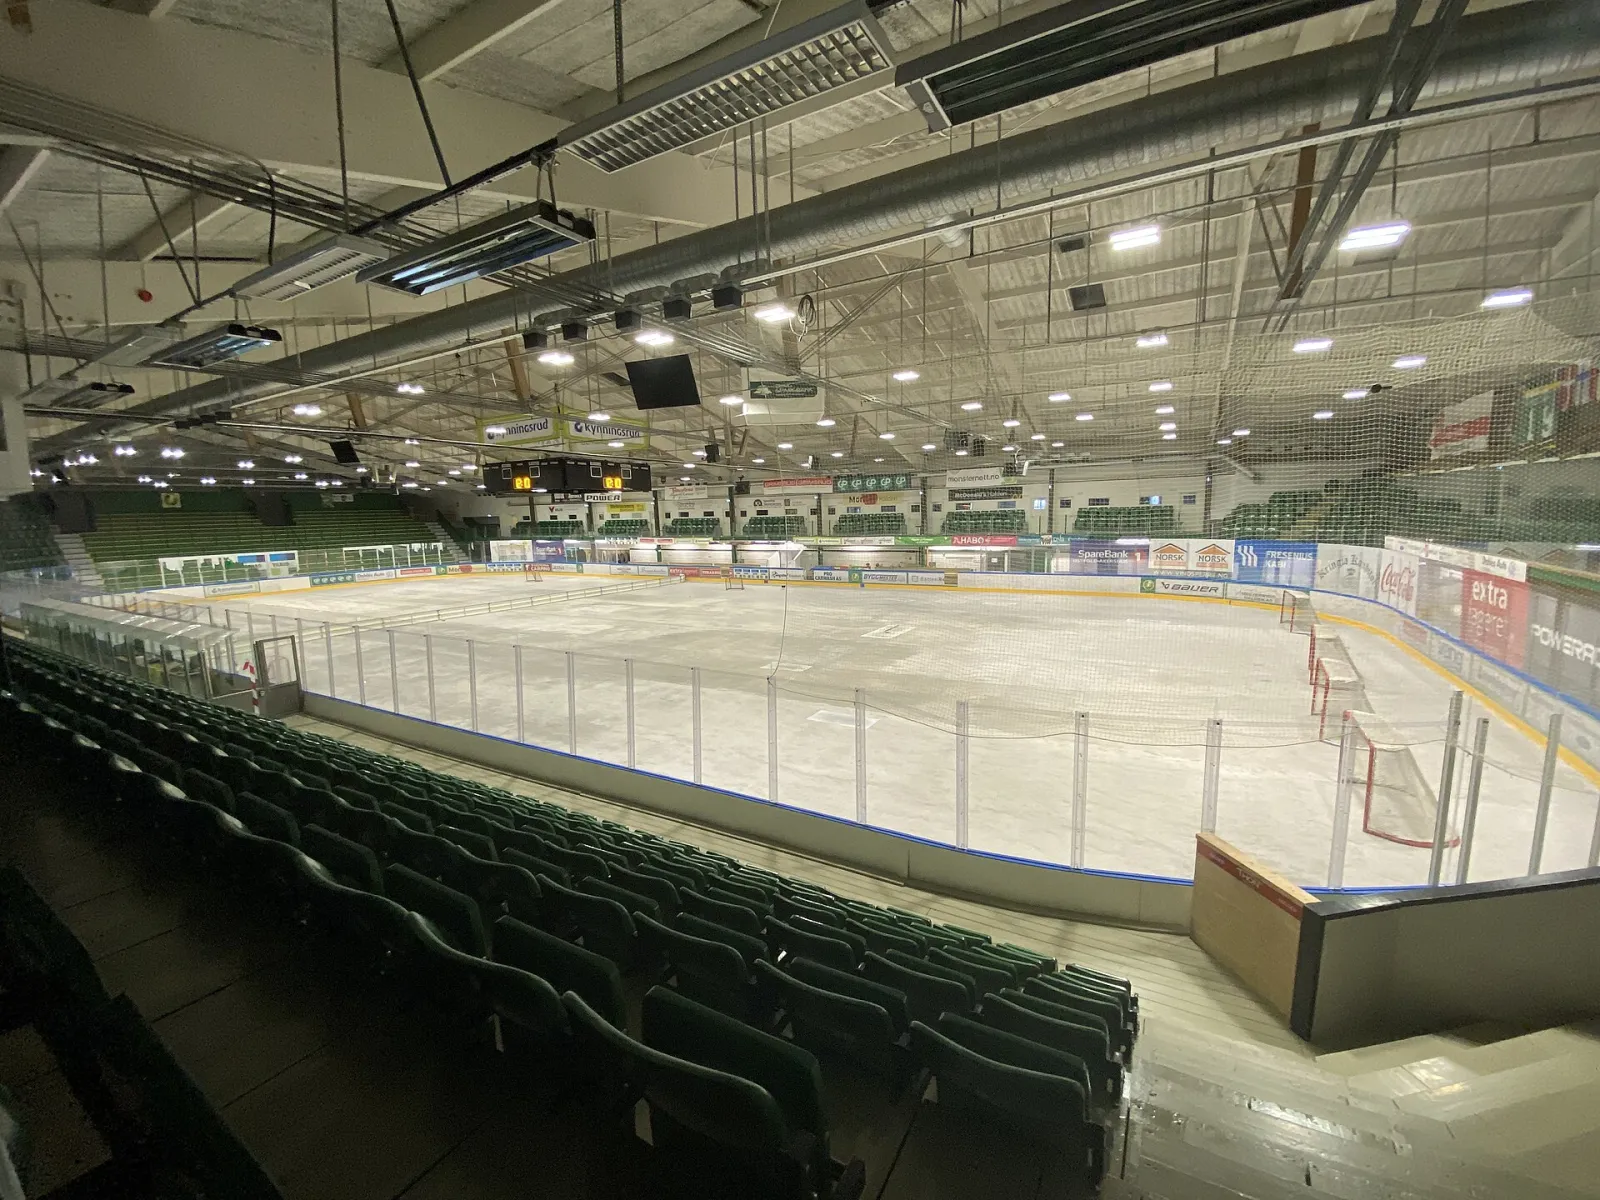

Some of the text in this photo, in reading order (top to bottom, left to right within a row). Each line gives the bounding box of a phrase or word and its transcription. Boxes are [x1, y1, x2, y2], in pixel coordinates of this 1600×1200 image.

[496, 418, 549, 438] nningsrud
[961, 536, 984, 544] HABO
[1078, 549, 1141, 562] SpareBank 1
[1265, 550, 1314, 561] FRESENIUS
[1264, 559, 1287, 568] KABI
[1171, 583, 1219, 593] BAUER
[1472, 580, 1508, 610] extra
